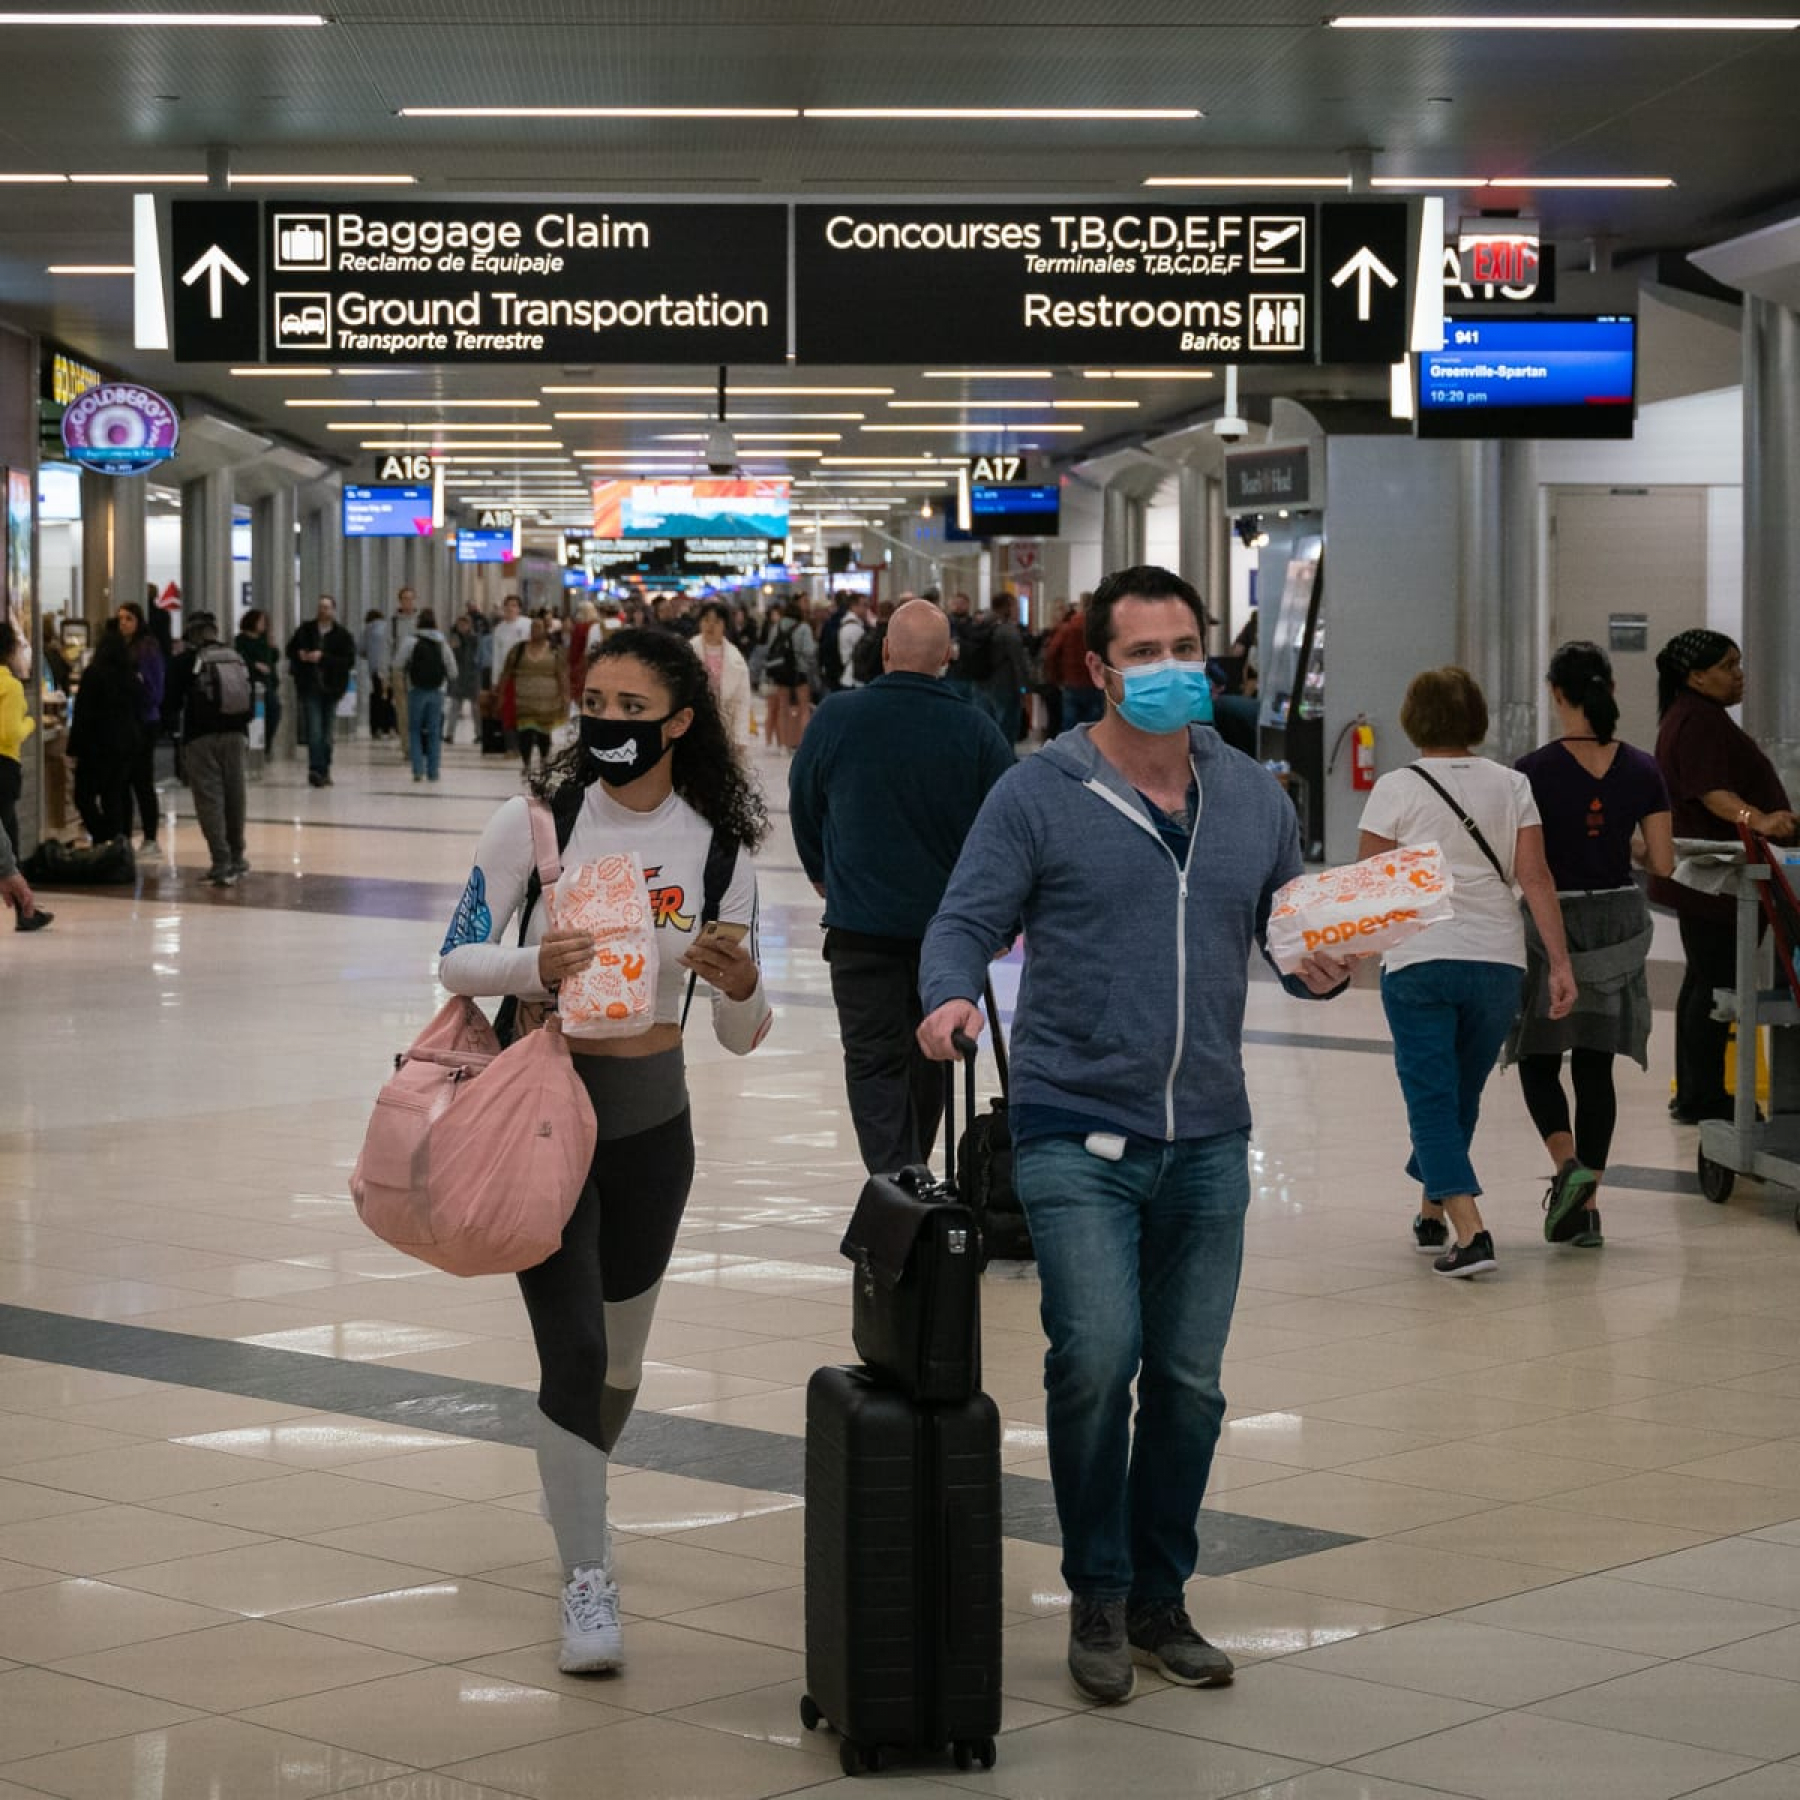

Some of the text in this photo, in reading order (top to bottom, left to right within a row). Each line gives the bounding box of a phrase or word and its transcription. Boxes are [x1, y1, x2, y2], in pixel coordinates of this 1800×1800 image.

[338, 213, 649, 254] Baggage Claim
[826, 215, 1243, 253] Concourses T,B,C,D,E,F
[338, 252, 565, 276] Reclamo de Equipaje
[1024, 254, 1243, 276] Terminales T,B,C,D,E,F
[1473, 241, 1528, 282] EXIT
[336, 291, 768, 333] Ground Transportation
[1025, 293, 1242, 328] Restrooms
[337, 330, 544, 354] Transporte Terrestre
[1180, 332, 1242, 351] Baños
[1455, 330, 1479, 345] 941
[1466, 392, 1488, 405] pm
[380, 455, 431, 480] A16
[971, 456, 1021, 481] A17
